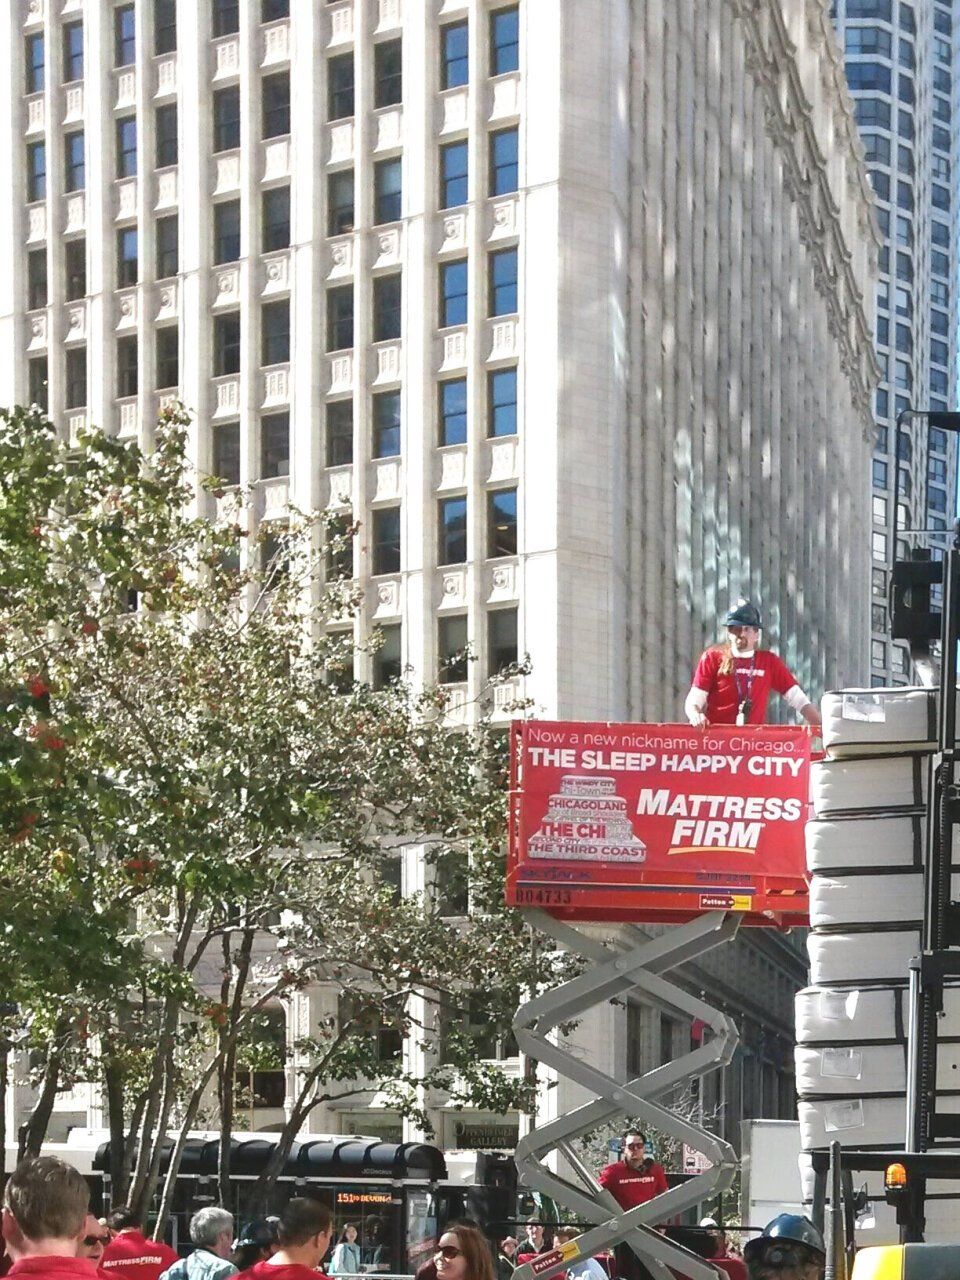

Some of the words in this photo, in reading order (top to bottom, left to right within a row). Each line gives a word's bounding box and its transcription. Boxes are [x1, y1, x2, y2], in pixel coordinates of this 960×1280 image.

[527, 728, 566, 744] Now
[569, 733, 579, 745] a
[583, 733, 617, 746] new
[621, 731, 699, 751] nickname
[702, 735, 725, 751] for
[729, 737, 804, 755] Chicago...
[527, 747, 576, 769] THE
[582, 750, 657, 772] SLEEP
[661, 753, 743, 775] HAPPY
[747, 756, 806, 777] CITY
[600, 780, 616, 788] CITY
[548, 799, 628, 811] CHICAGOLAND
[636, 788, 802, 822] MATTRESS
[541, 822, 574, 838] THE
[577, 823, 606, 839] CHI
[671, 820, 763, 848] FIRM
[528, 843, 553, 853] THE
[556, 844, 598, 855] THIRD
[601, 846, 647, 857] COAST
[336, 1193, 355, 1204] 151
